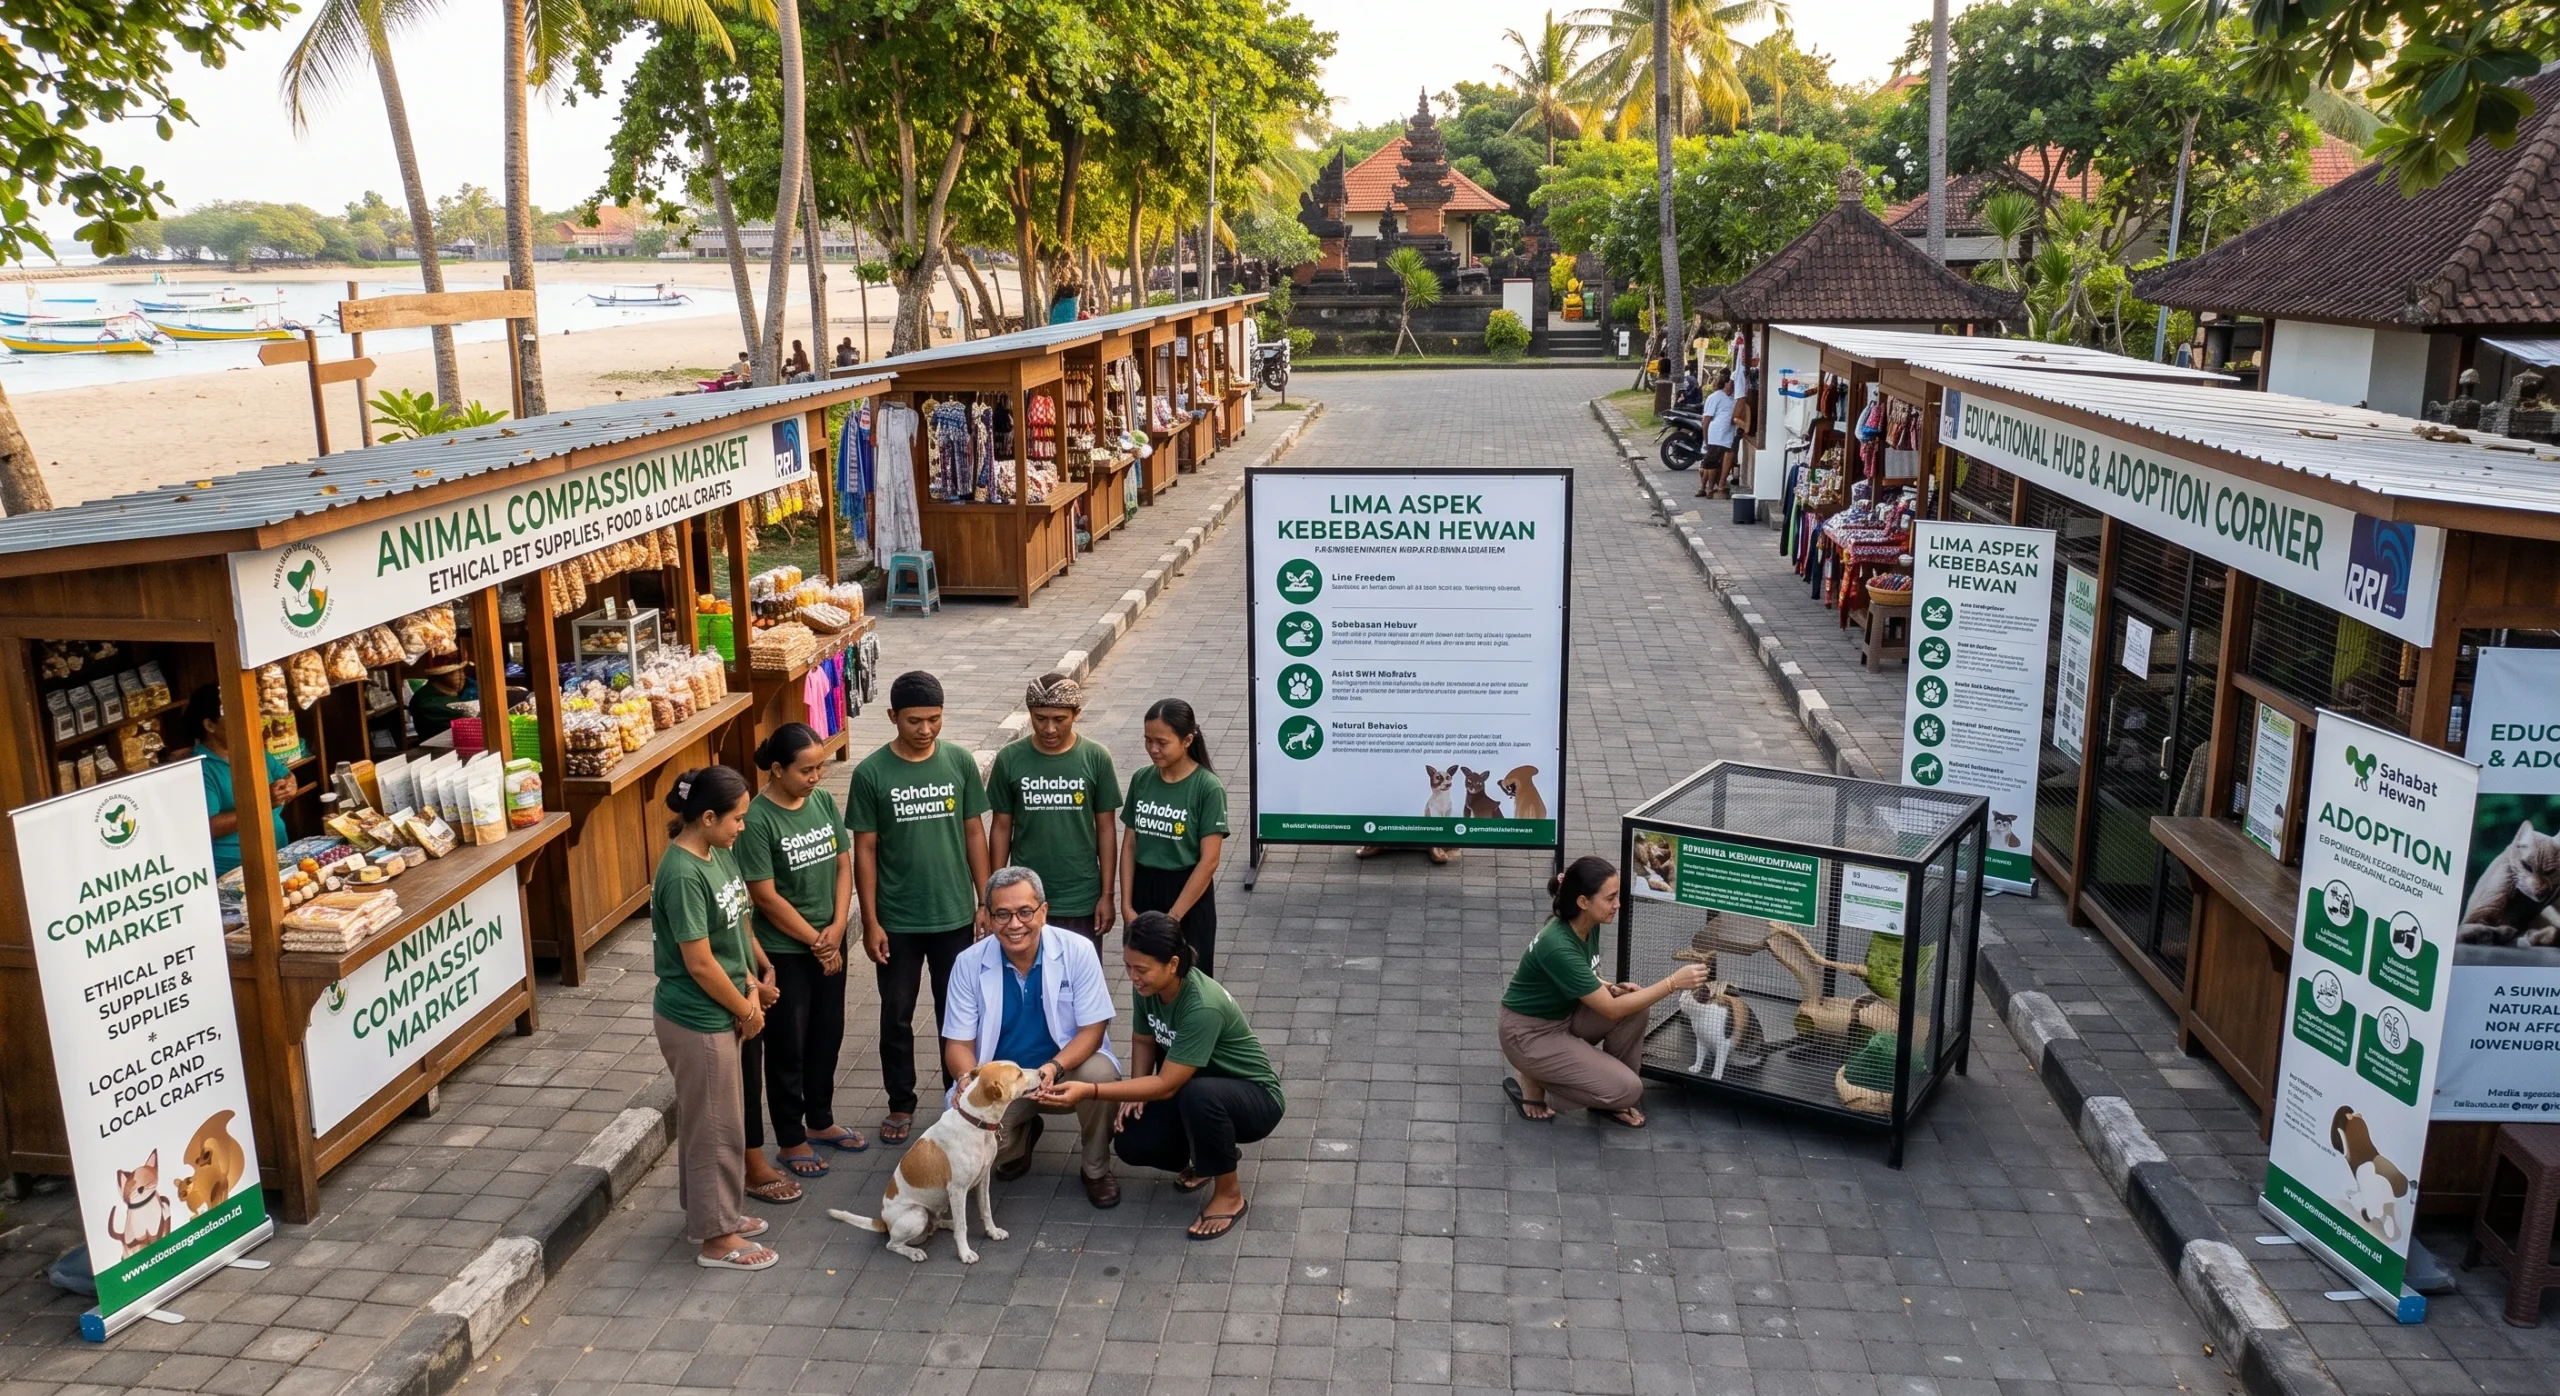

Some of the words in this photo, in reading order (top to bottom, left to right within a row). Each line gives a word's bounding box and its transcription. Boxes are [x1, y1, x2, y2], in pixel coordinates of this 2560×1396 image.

[1964, 403, 2049, 468] EDUCATIONAL
[2052, 432, 2087, 480] HUB
[2088, 446, 2100, 487] &
[2103, 452, 2209, 529] ADOPTION
[2215, 486, 2324, 572] CORNER
[376, 503, 501, 578] ANIMAL
[507, 462, 666, 536] COMPASSION
[672, 434, 749, 486] MARKET
[1330, 494, 1392, 514] LIMA
[1398, 494, 1483, 515] ASPEK
[429, 552, 500, 595] ETHICAL
[503, 542, 531, 571] PET
[534, 520, 605, 560] SUPPLIES,
[607, 508, 642, 534] FOOD
[645, 504, 654, 521] &
[656, 493, 692, 520] LOCAL
[693, 480, 732, 507] CRAFTS
[1278, 520, 1430, 540] KEBEBASAN
[1439, 520, 1535, 540] HEWAN
[1930, 536, 1973, 553] LIMA
[1978, 540, 2040, 559] ASPEK
[1332, 573, 1353, 581] Line
[1928, 554, 2038, 578] KEBEBASAN
[1948, 574, 2017, 594] HEWAN
[2344, 562, 2388, 613] RRI
[2488, 750, 2506, 767] &
[890, 782, 955, 802] Sahabat
[1021, 776, 1085, 790] Sahabat
[2380, 763, 2438, 797] Sahabat
[893, 800, 945, 817] Hewan
[1022, 791, 1073, 804] Hewan
[1136, 800, 1188, 822] Sahabat
[2379, 781, 2426, 812] Hewan
[781, 823, 835, 851] Sahabat
[2318, 801, 2452, 876] ADOPTION
[787, 841, 833, 866] Hewan
[78, 854, 175, 904] ANIMAL
[47, 867, 209, 942] COMPASSION
[84, 904, 185, 959] MARKET
[384, 901, 474, 983] ANIMAL
[83, 962, 158, 1003] ETHICAL
[163, 945, 196, 970] PET
[181, 970, 193, 986] &
[353, 915, 503, 1039] COMPASSION
[2494, 985, 2506, 996] A
[107, 993, 190, 1040] SUPPLIES
[387, 966, 480, 1058] MARKET
[88, 1059, 147, 1097] LOCAL
[150, 1026, 222, 1067] CRAFTS,
[114, 1073, 164, 1108] FOOD
[168, 1054, 205, 1084] AND
[99, 1102, 157, 1139] LOCAL
[160, 1068, 225, 1108] CRAFTS
